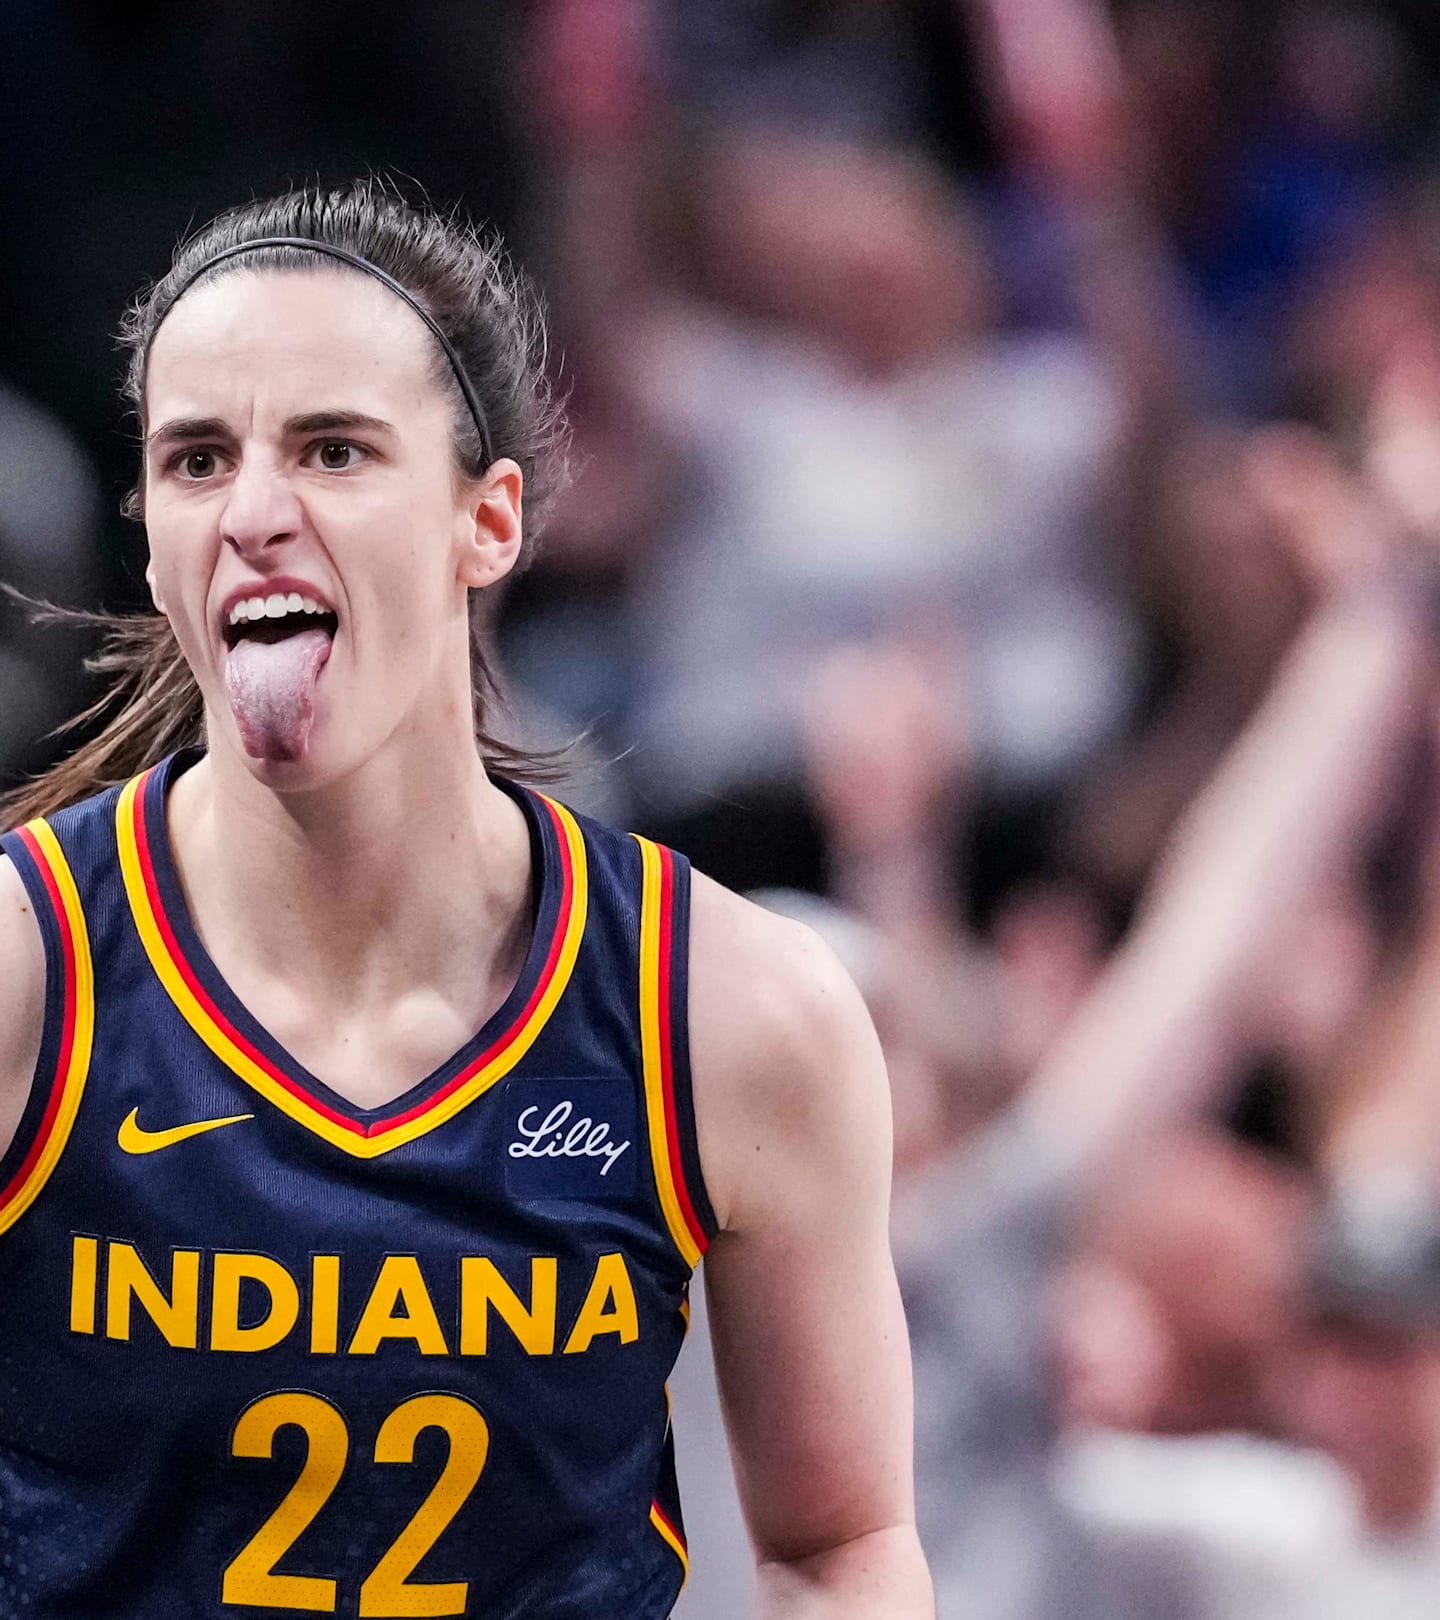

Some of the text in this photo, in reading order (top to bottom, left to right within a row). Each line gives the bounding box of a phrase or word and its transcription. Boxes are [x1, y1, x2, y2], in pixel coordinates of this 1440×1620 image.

[508, 1100, 631, 1177] Lilly
[70, 1235, 640, 1356] INDIANA
[221, 1392, 490, 1618] 22
